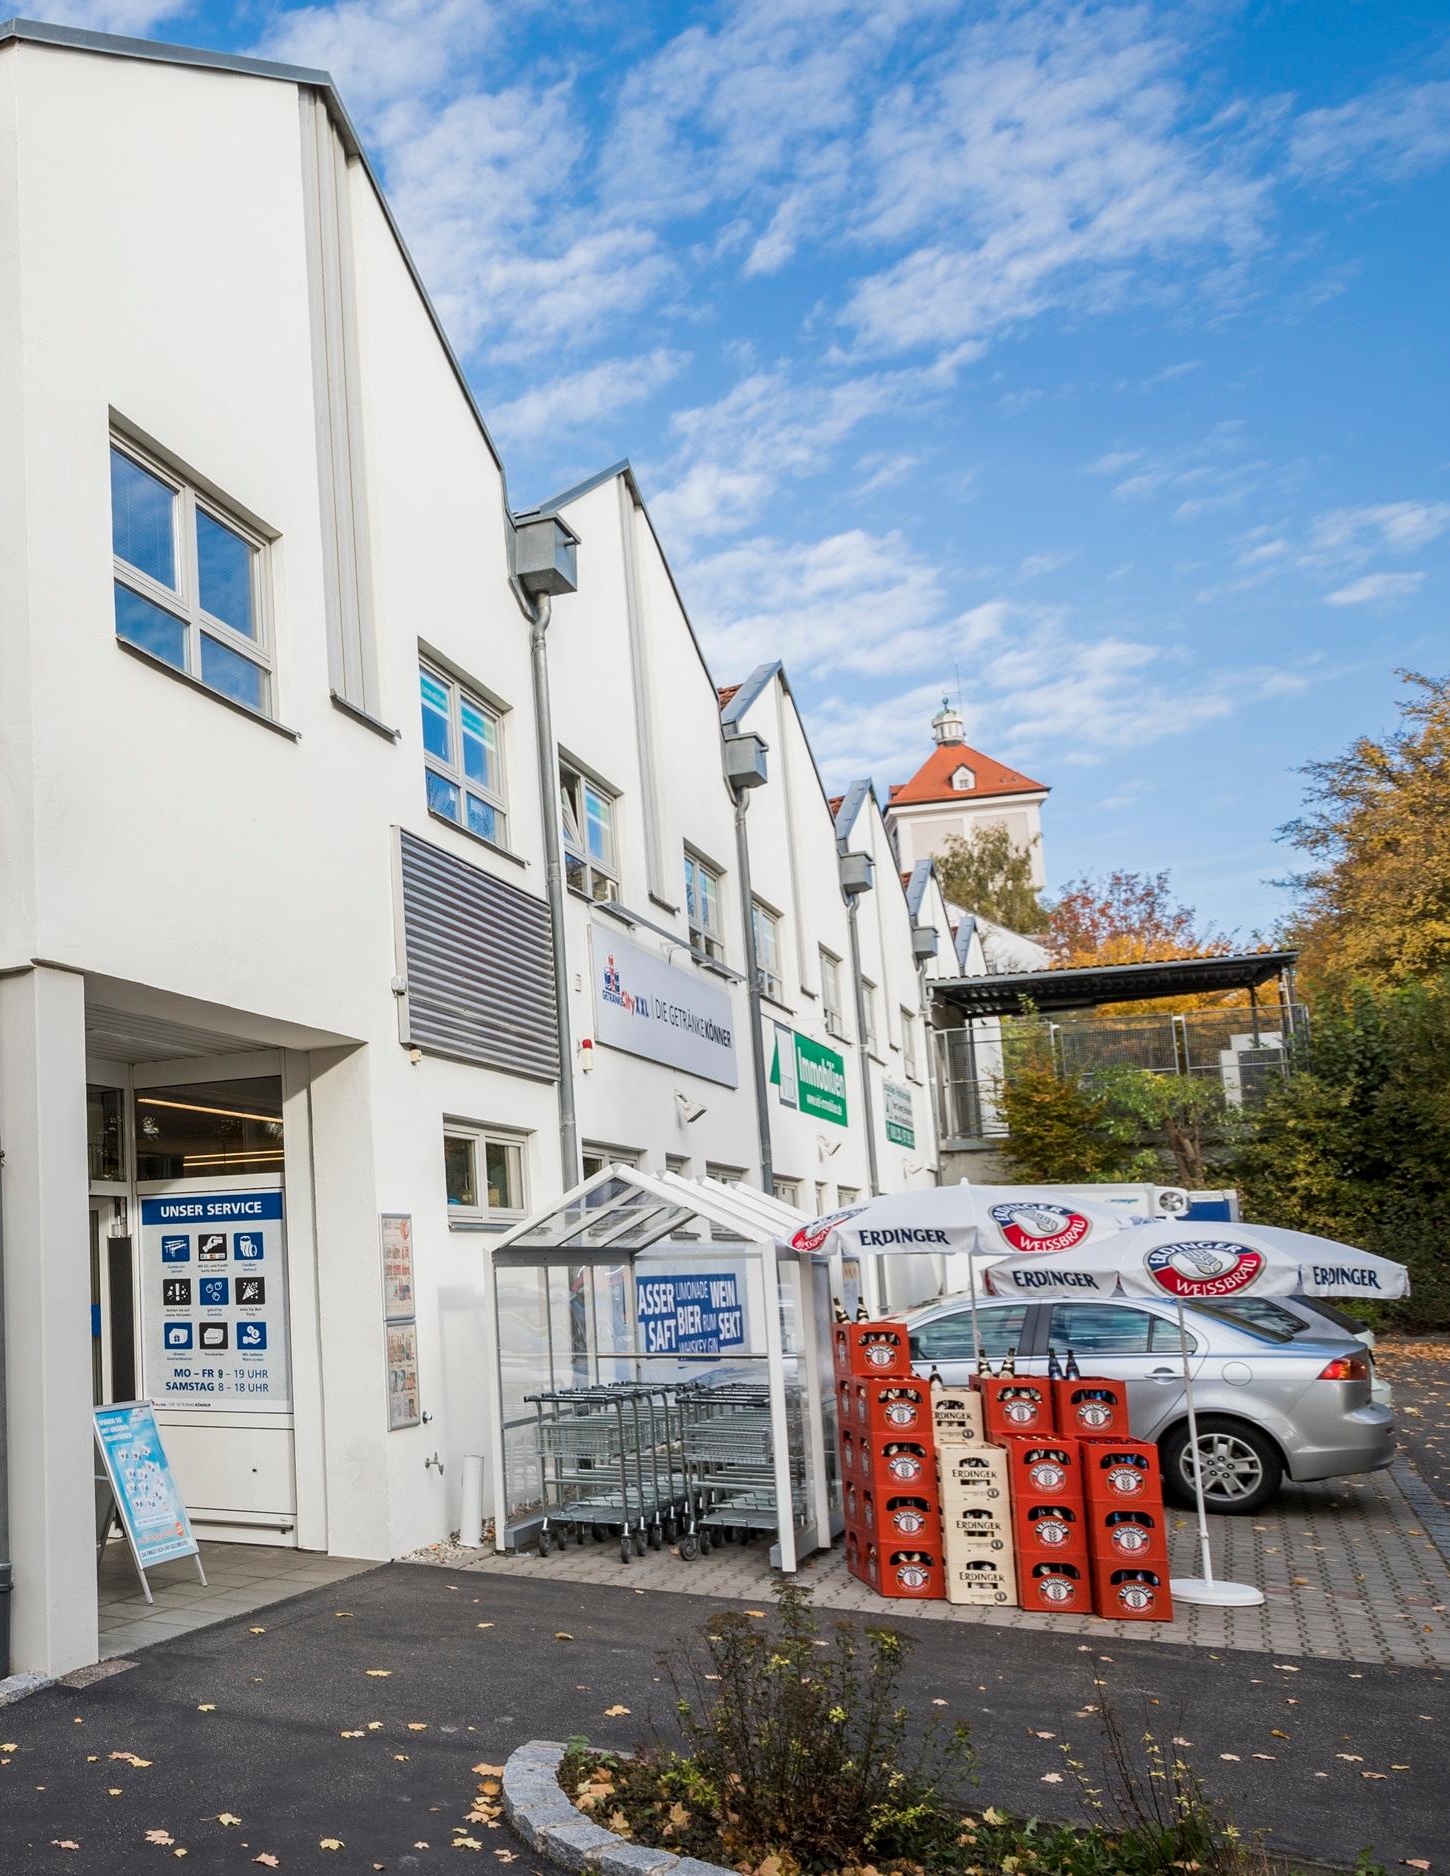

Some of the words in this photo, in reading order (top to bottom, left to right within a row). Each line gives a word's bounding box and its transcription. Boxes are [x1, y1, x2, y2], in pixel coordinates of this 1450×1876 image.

[634, 996, 649, 1018] XXL
[655, 999, 668, 1022] DIE
[668, 1005, 704, 1038] GETRÄNKE
[704, 1019, 732, 1048] KÖNNER
[797, 1046, 846, 1100] Immobilien
[160, 1204, 203, 1218] UNSER
[206, 1201, 262, 1216] SERVICE
[994, 1204, 1063, 1222] ERDINGER
[859, 1230, 950, 1247] ERDINGER
[1150, 1242, 1242, 1264] ERDINGER
[1012, 1270, 1100, 1290] ERDINGER
[1314, 1265, 1382, 1290] ERDINGER
[676, 1281, 708, 1300] LIMONADE
[710, 1280, 736, 1308] WEIN
[678, 1306, 702, 1336] BIER
[718, 1311, 741, 1340] SEKT
[648, 1319, 676, 1352] SAFT
[174, 1369, 191, 1377] MO
[202, 1369, 214, 1378] FR
[234, 1370, 245, 1378] 19
[248, 1369, 268, 1378] UHR
[165, 1382, 214, 1391] SAMSTAG
[218, 1383, 224, 1392] 8
[235, 1383, 245, 1392] 18
[248, 1383, 269, 1392] UHR
[933, 1412, 973, 1420] RDINGER
[952, 1469, 998, 1478] ERDINGER
